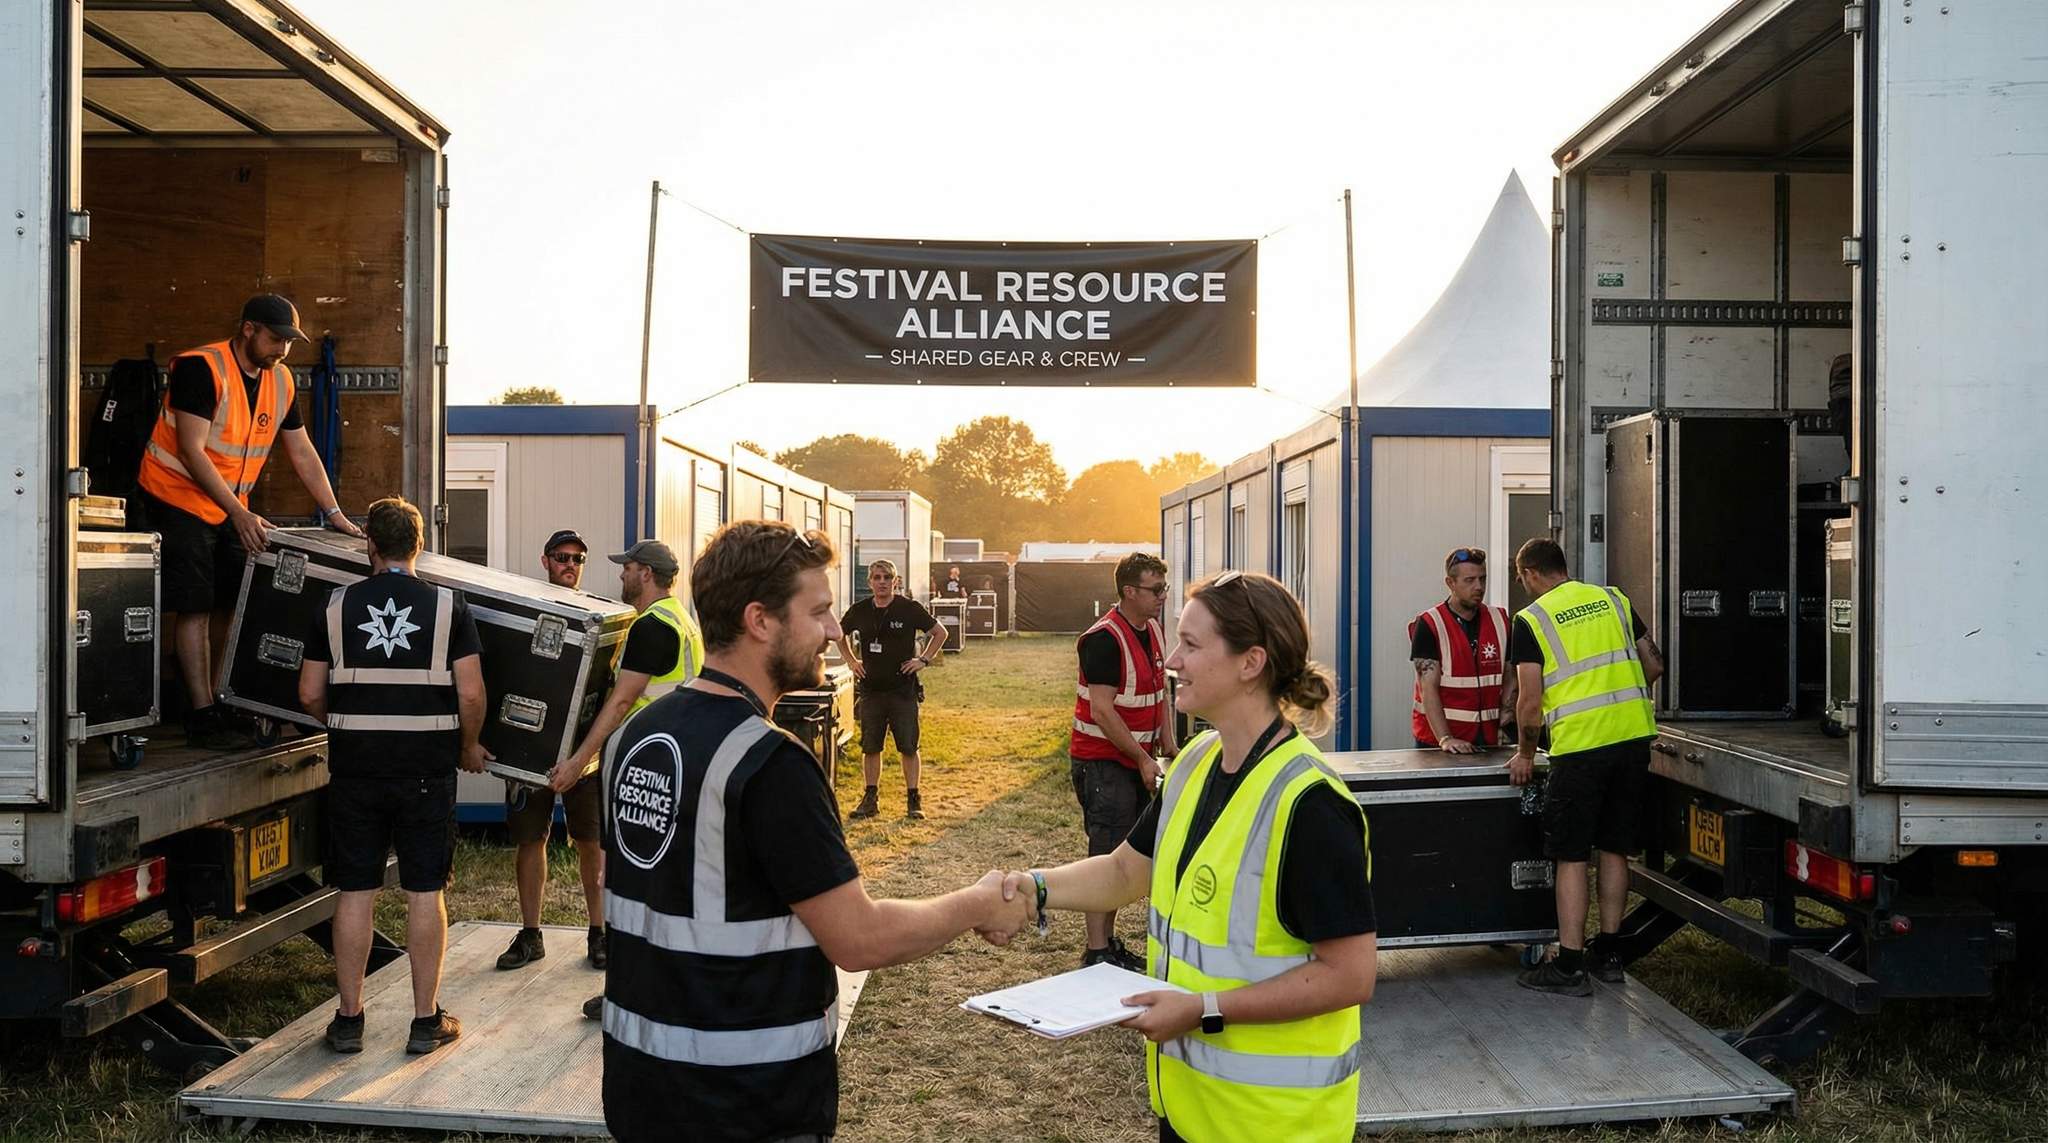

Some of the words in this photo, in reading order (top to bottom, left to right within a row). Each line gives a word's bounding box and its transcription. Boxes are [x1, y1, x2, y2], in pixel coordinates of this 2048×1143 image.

[782, 266, 983, 302] FESTIVAL
[997, 271, 1226, 303] RESOURCE
[895, 307, 1111, 341] ALLIANCE
[890, 348, 973, 366] SHARED
[978, 350, 1035, 367] GEAR
[1040, 350, 1055, 367] &
[1059, 350, 1121, 367] CREW
[625, 765, 672, 794] FESTIVAL
[618, 783, 673, 815] RESOURCE
[617, 803, 668, 834] ALLIANCE
